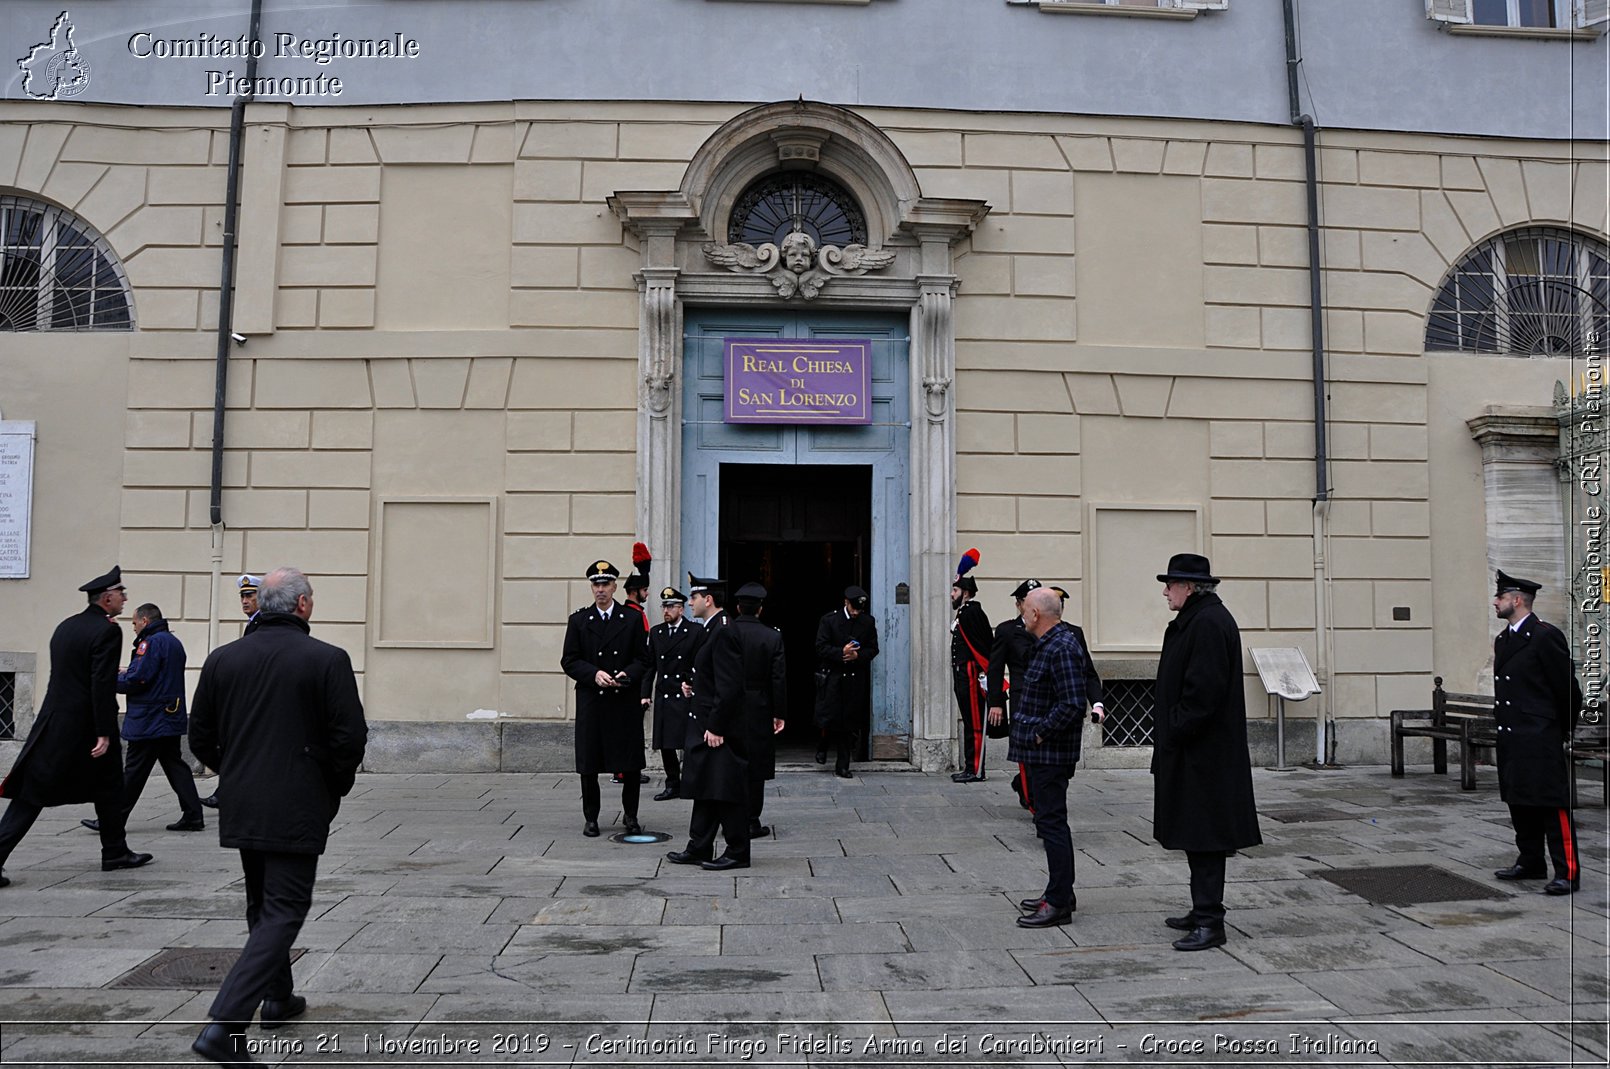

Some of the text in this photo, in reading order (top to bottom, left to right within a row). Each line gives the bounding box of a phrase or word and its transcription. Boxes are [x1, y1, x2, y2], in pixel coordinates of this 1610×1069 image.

[742, 355, 854, 374] REAL CHIESA
[791, 378, 805, 389] DI
[738, 388, 857, 406] SAN LORENZO
